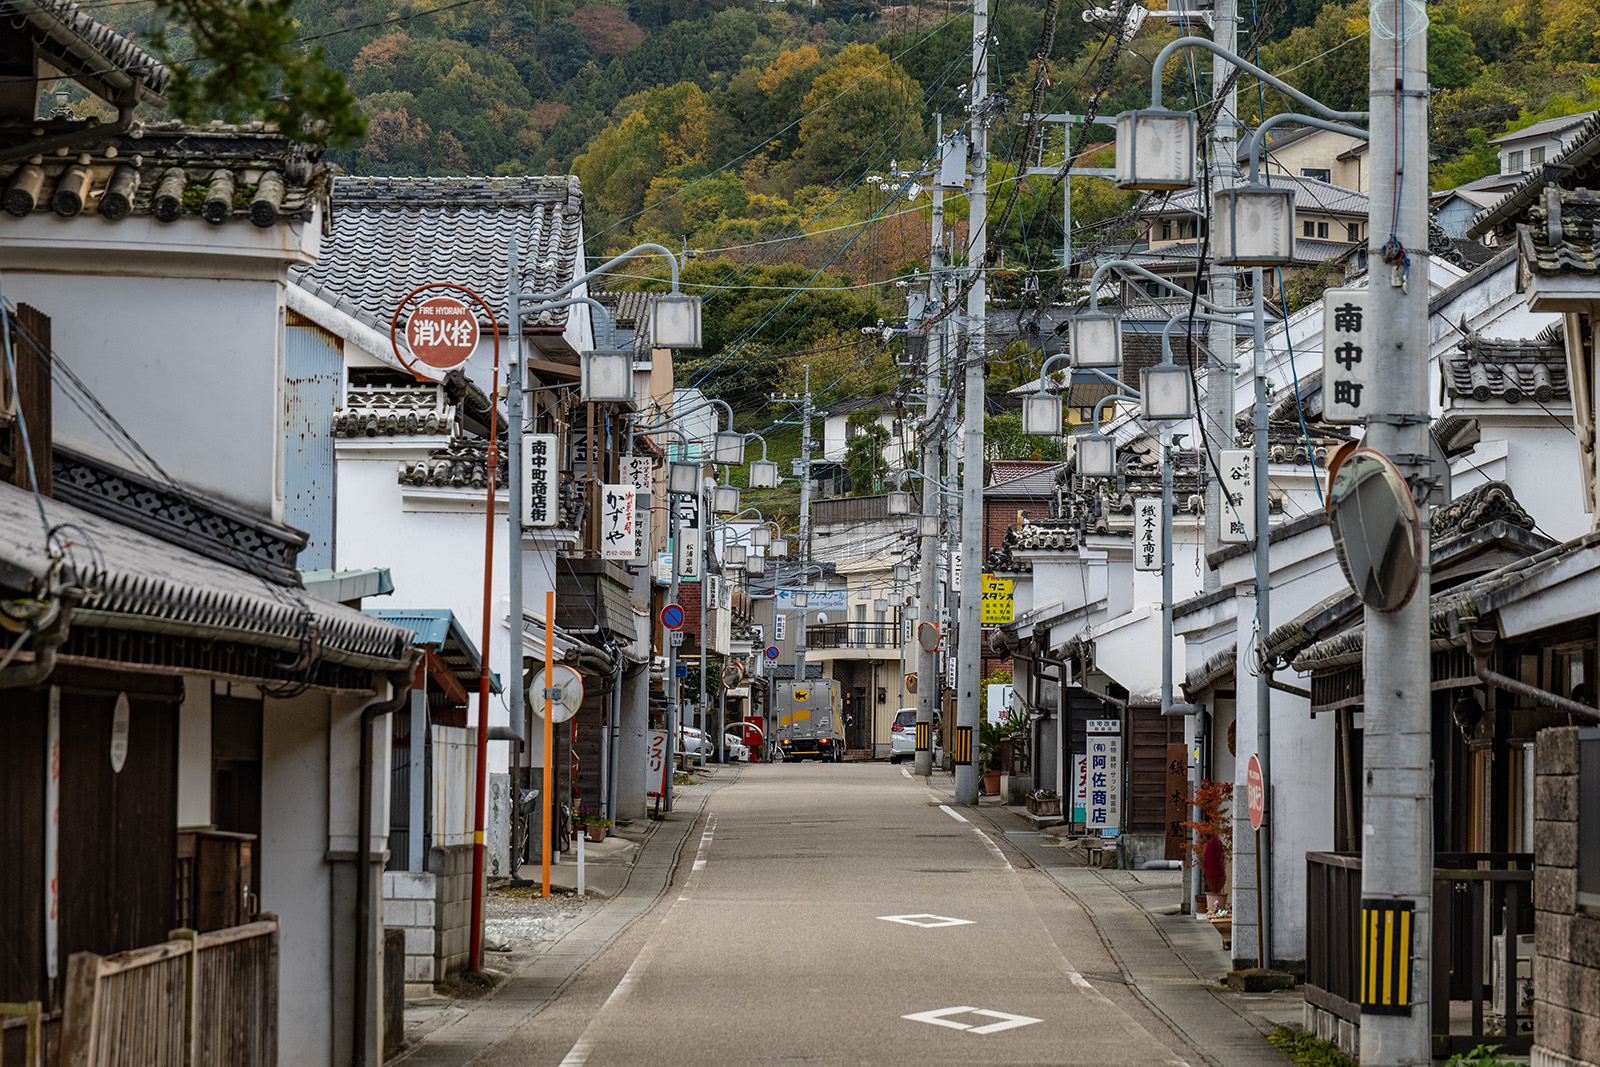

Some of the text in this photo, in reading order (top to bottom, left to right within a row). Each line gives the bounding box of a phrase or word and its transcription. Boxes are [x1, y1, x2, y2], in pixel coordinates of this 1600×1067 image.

[419, 306, 467, 315] FIRE HYDRANT
[413, 319, 473, 347] 消火栓
[1334, 302, 1364, 408] 南中町
[531, 440, 548, 522] 南中町商店街
[605, 490, 625, 546] かずや
[1141, 505, 1156, 567] 織本屋商事
[684, 543, 694, 575] 松浦薬局
[981, 592, 1014, 600] スタジオ
[989, 583, 1005, 591] タニ
[650, 736, 664, 772] クスリ
